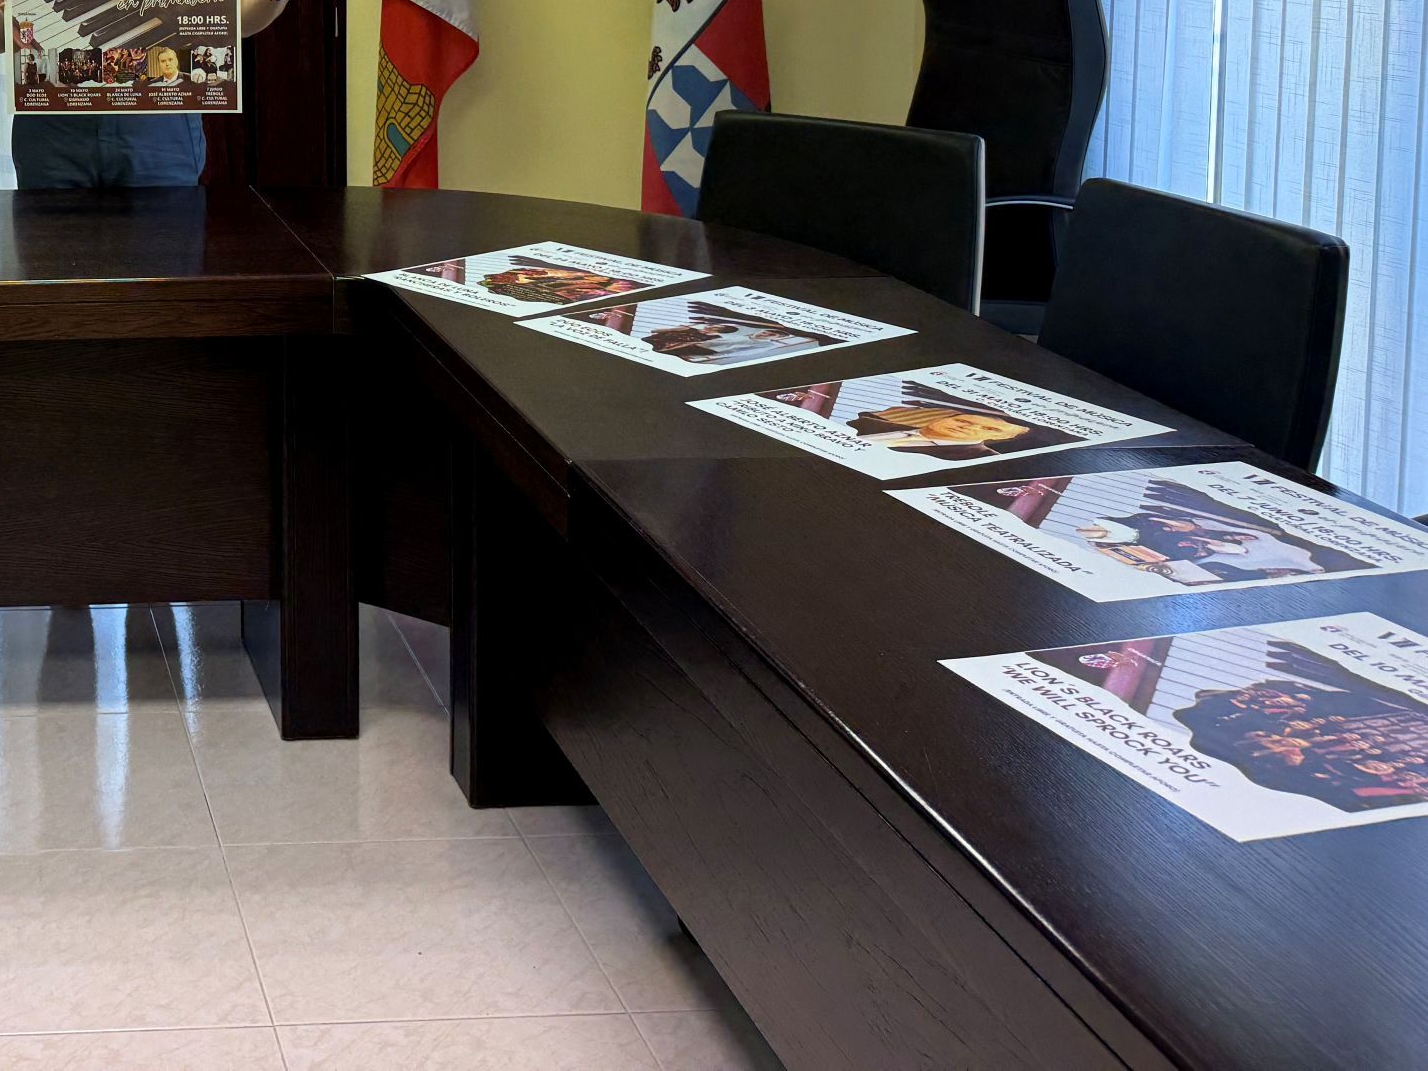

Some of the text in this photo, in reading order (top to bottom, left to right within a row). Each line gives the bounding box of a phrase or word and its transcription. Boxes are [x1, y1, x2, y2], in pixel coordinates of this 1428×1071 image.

[176, 15, 230, 25] 18:00 HRS.
[935, 381, 962, 389] DEL
[976, 394, 1022, 408] MAYO
[988, 381, 1052, 402] FESTIVAL
[1054, 401, 1078, 409] DE
[716, 402, 758, 418] CAMILO
[741, 399, 872, 447] JOSÉ ALBERTO AZNAR
[814, 433, 854, 448] BRAVO
[1243, 474, 1379, 527] VII FESTIVAL DE
[1207, 484, 1240, 496] DEL
[1250, 502, 1305, 522] JUNIO
[1359, 546, 1404, 564] HRS.
[1261, 511, 1314, 534] CULTURAL
[1314, 534, 1383, 562] LORENZANA
[1328, 643, 1369, 661] DEL
[1377, 631, 1420, 648] VII
[1032, 686, 1076, 710] WILL
[1075, 712, 1161, 756] SPROCK
[1074, 696, 1144, 730] BLACK
[1137, 732, 1211, 769] ROARS
